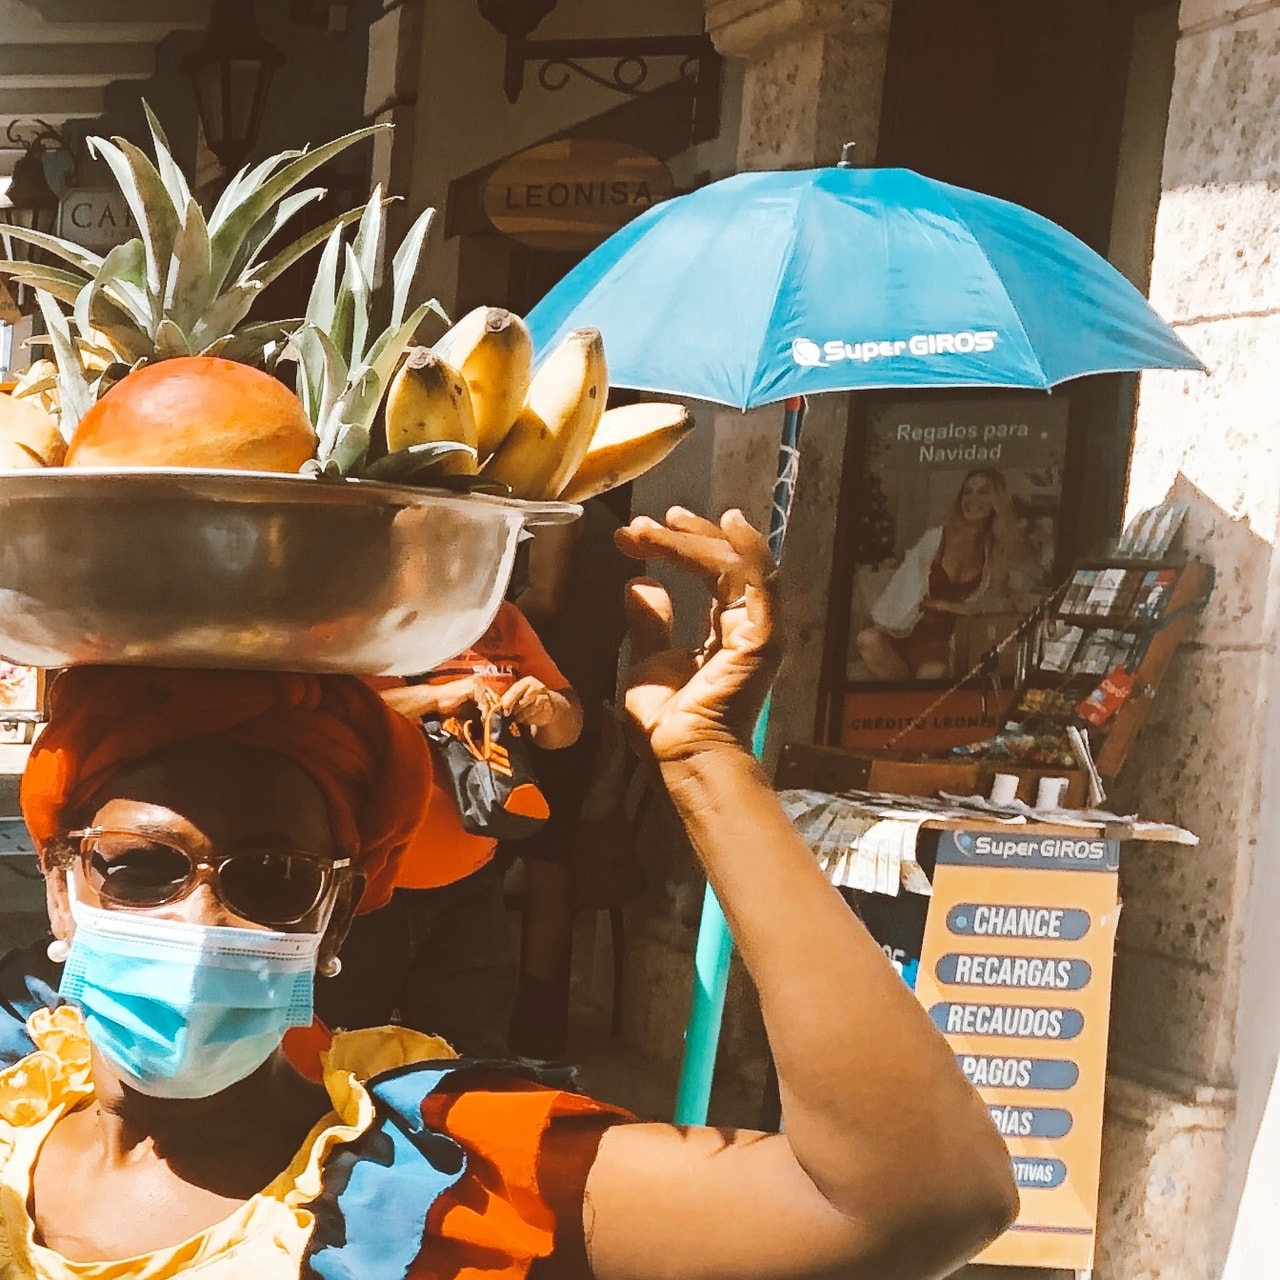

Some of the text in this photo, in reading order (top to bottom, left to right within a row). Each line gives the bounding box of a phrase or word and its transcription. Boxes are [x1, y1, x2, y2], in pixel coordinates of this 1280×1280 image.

[505, 181, 652, 209] LEONISA
[897, 422, 1029, 444] Regalos para
[919, 443, 1002, 463] Navidad
[973, 905, 1064, 938] CHANCE
[955, 955, 1071, 988] RECARGAS
[947, 1004, 1064, 1038] RECAUDOS
[962, 1056, 1032, 1088] PAGOS
